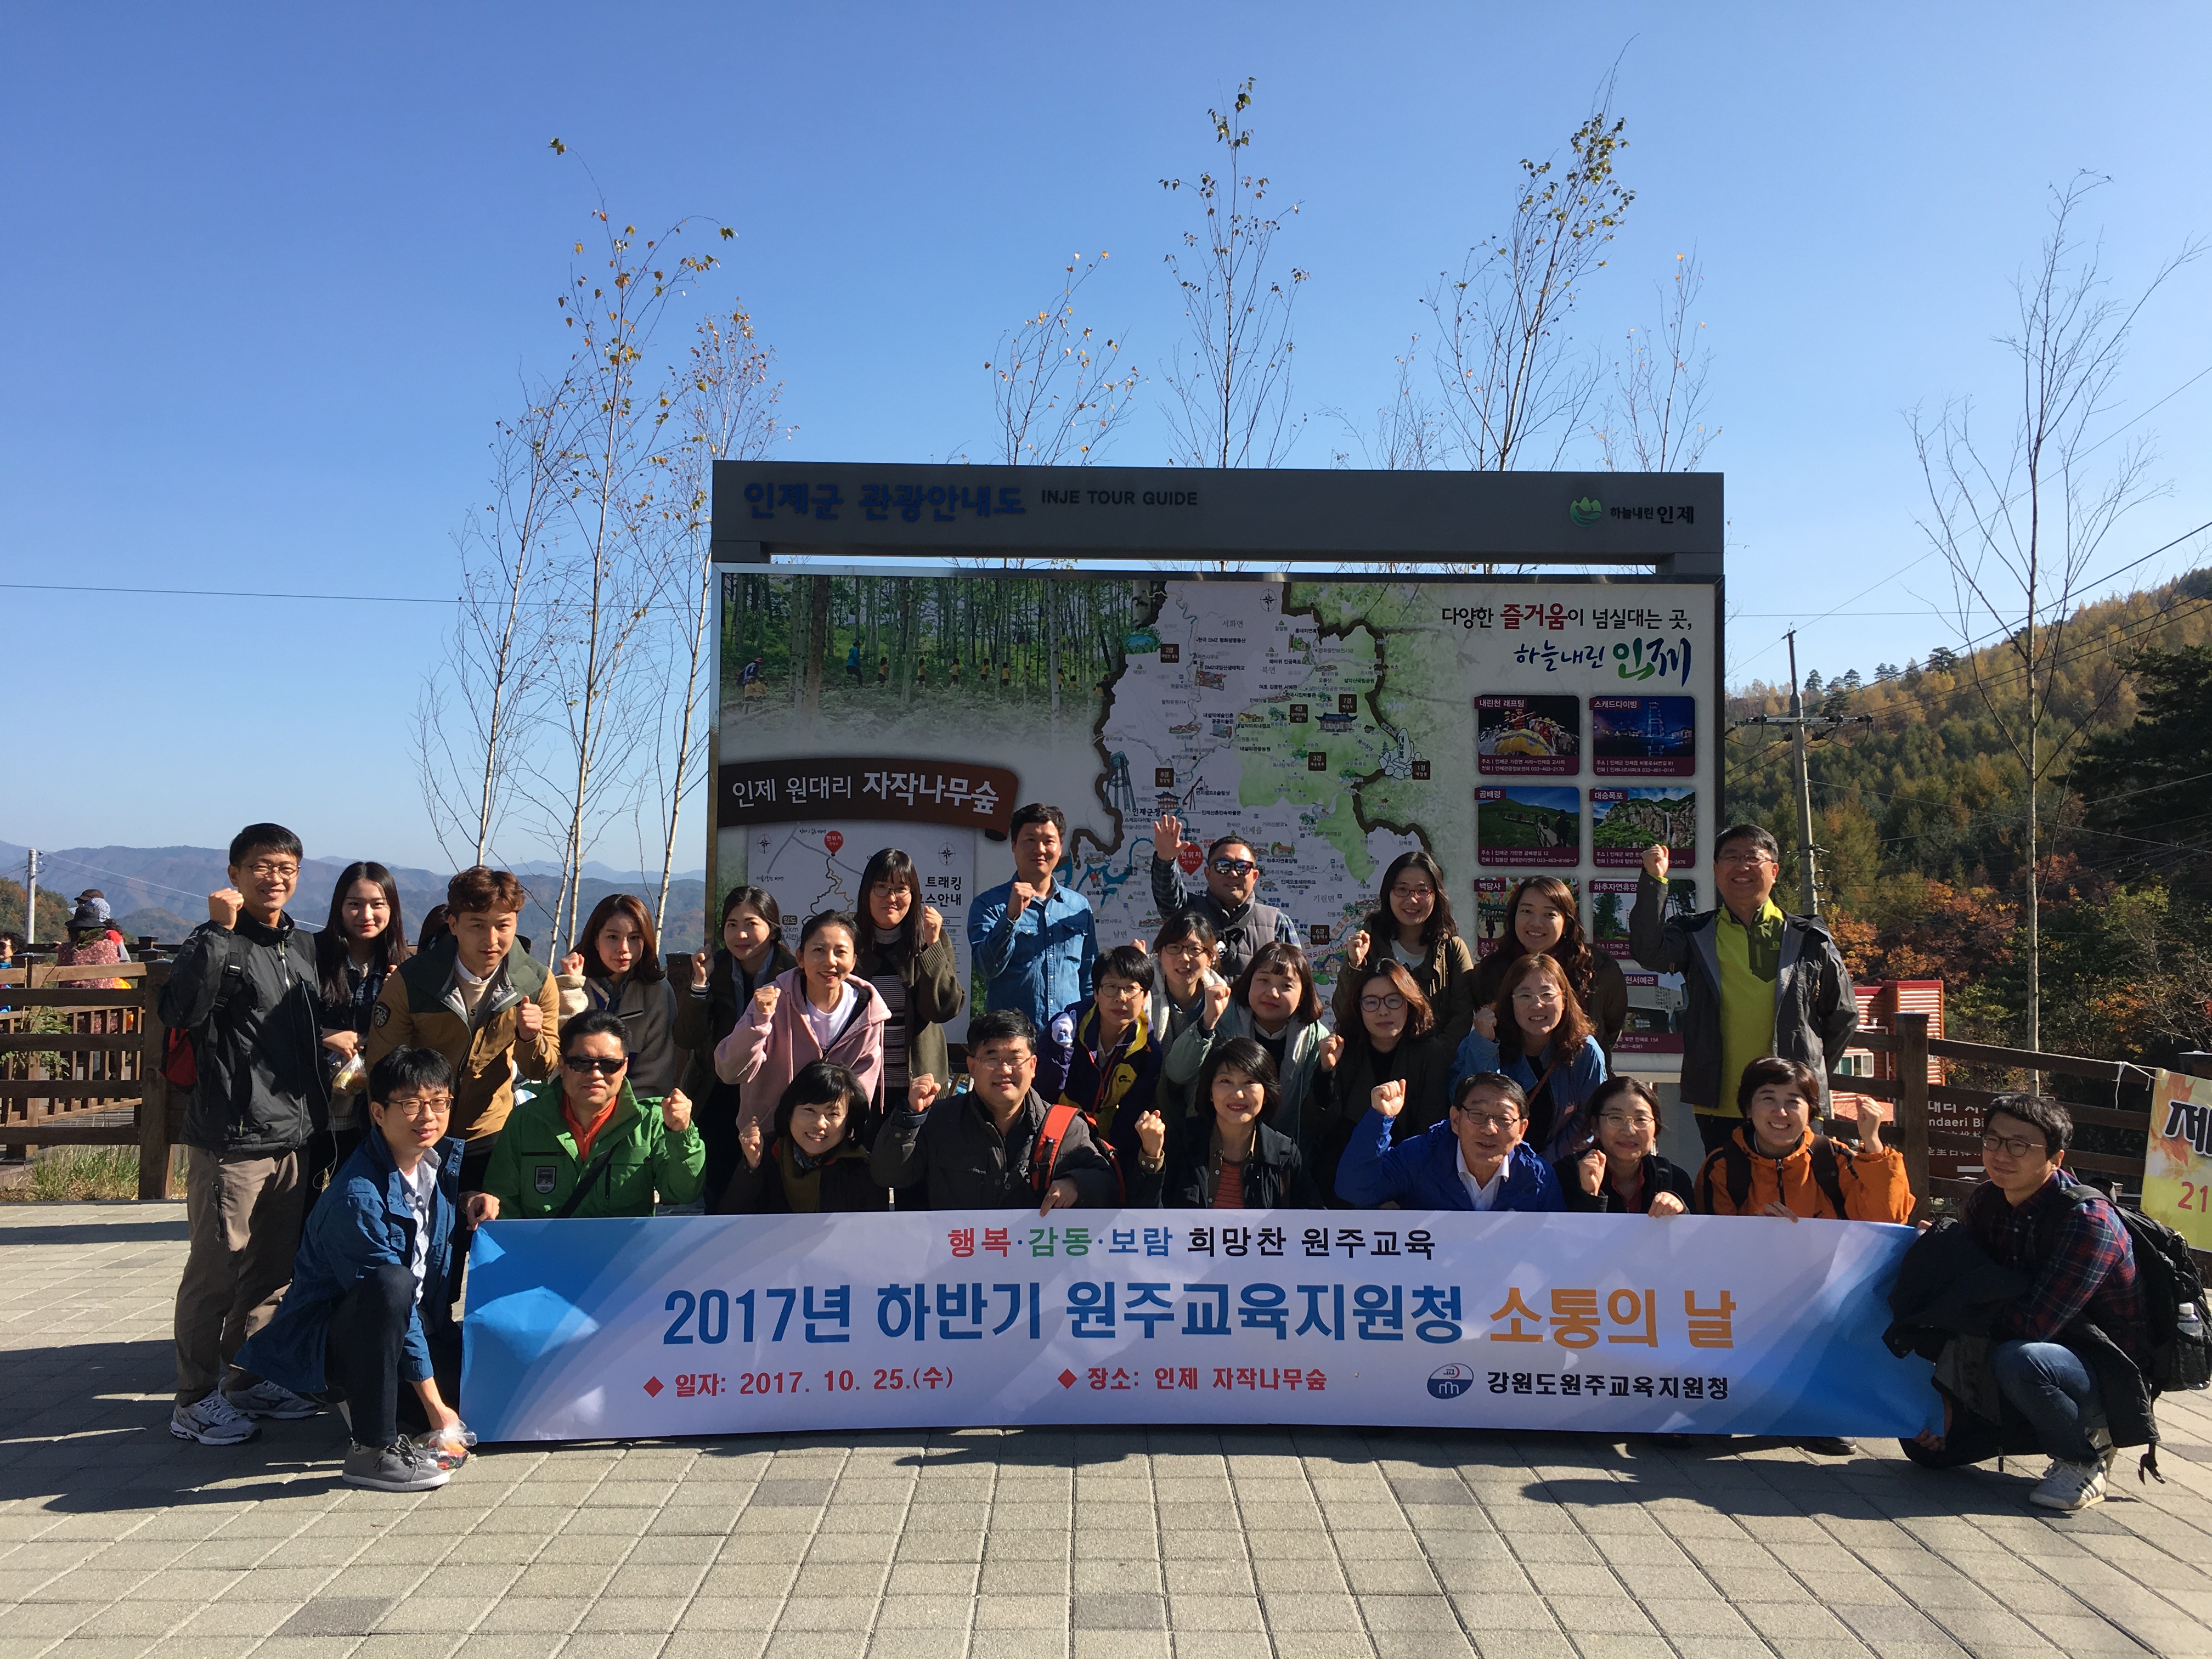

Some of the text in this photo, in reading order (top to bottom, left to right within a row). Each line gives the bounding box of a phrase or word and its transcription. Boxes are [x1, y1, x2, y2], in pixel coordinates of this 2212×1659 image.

[744, 482, 1027, 522] 인제군 관광안내도
[1041, 489, 1199, 506] INJE TOUR GUIDE
[1610, 505, 1695, 524] 하늘내린 인제
[1441, 602, 1692, 631] 다양한 즐거움이 넘실대는 곳,
[1222, 619, 1244, 628] 서화면
[1513, 636, 1692, 687] 하늘내린 인제
[1261, 666, 1276, 674] 북면
[1479, 699, 1525, 708] 내린천 래프팅
[1594, 700, 1638, 709] 스캐드다이빙
[732, 771, 1000, 815] 인제 원대리 자작나무숲
[1479, 789, 1501, 799] 곰배령
[1594, 791, 1624, 800] 대승폭포
[1132, 808, 1160, 817] 인제군청
[1241, 826, 1263, 835] 인제읍
[1181, 851, 1201, 860] 현위치
[925, 876, 962, 891] 트래킹
[1479, 881, 1501, 890] 백담사
[1594, 882, 1639, 892] 하추자연휴양
[1313, 894, 1334, 903] 기린면
[1625, 975, 1655, 984] 현서예관
[1928, 1117, 1984, 1127] ndaeri Bi
[1187, 1226, 1287, 1258] 희망찬
[1301, 1227, 1436, 1261] 원주교육
[663, 1281, 1737, 1349] 2017년 하반기 원주교육지원청 소통의 날
[674, 1366, 954, 1398] 일자: 2017. 10. 25.(수)
[1086, 1367, 1328, 1391] 장소: 인제 자작나무숲
[1487, 1371, 1729, 1401] 강원도원주교육지원청
